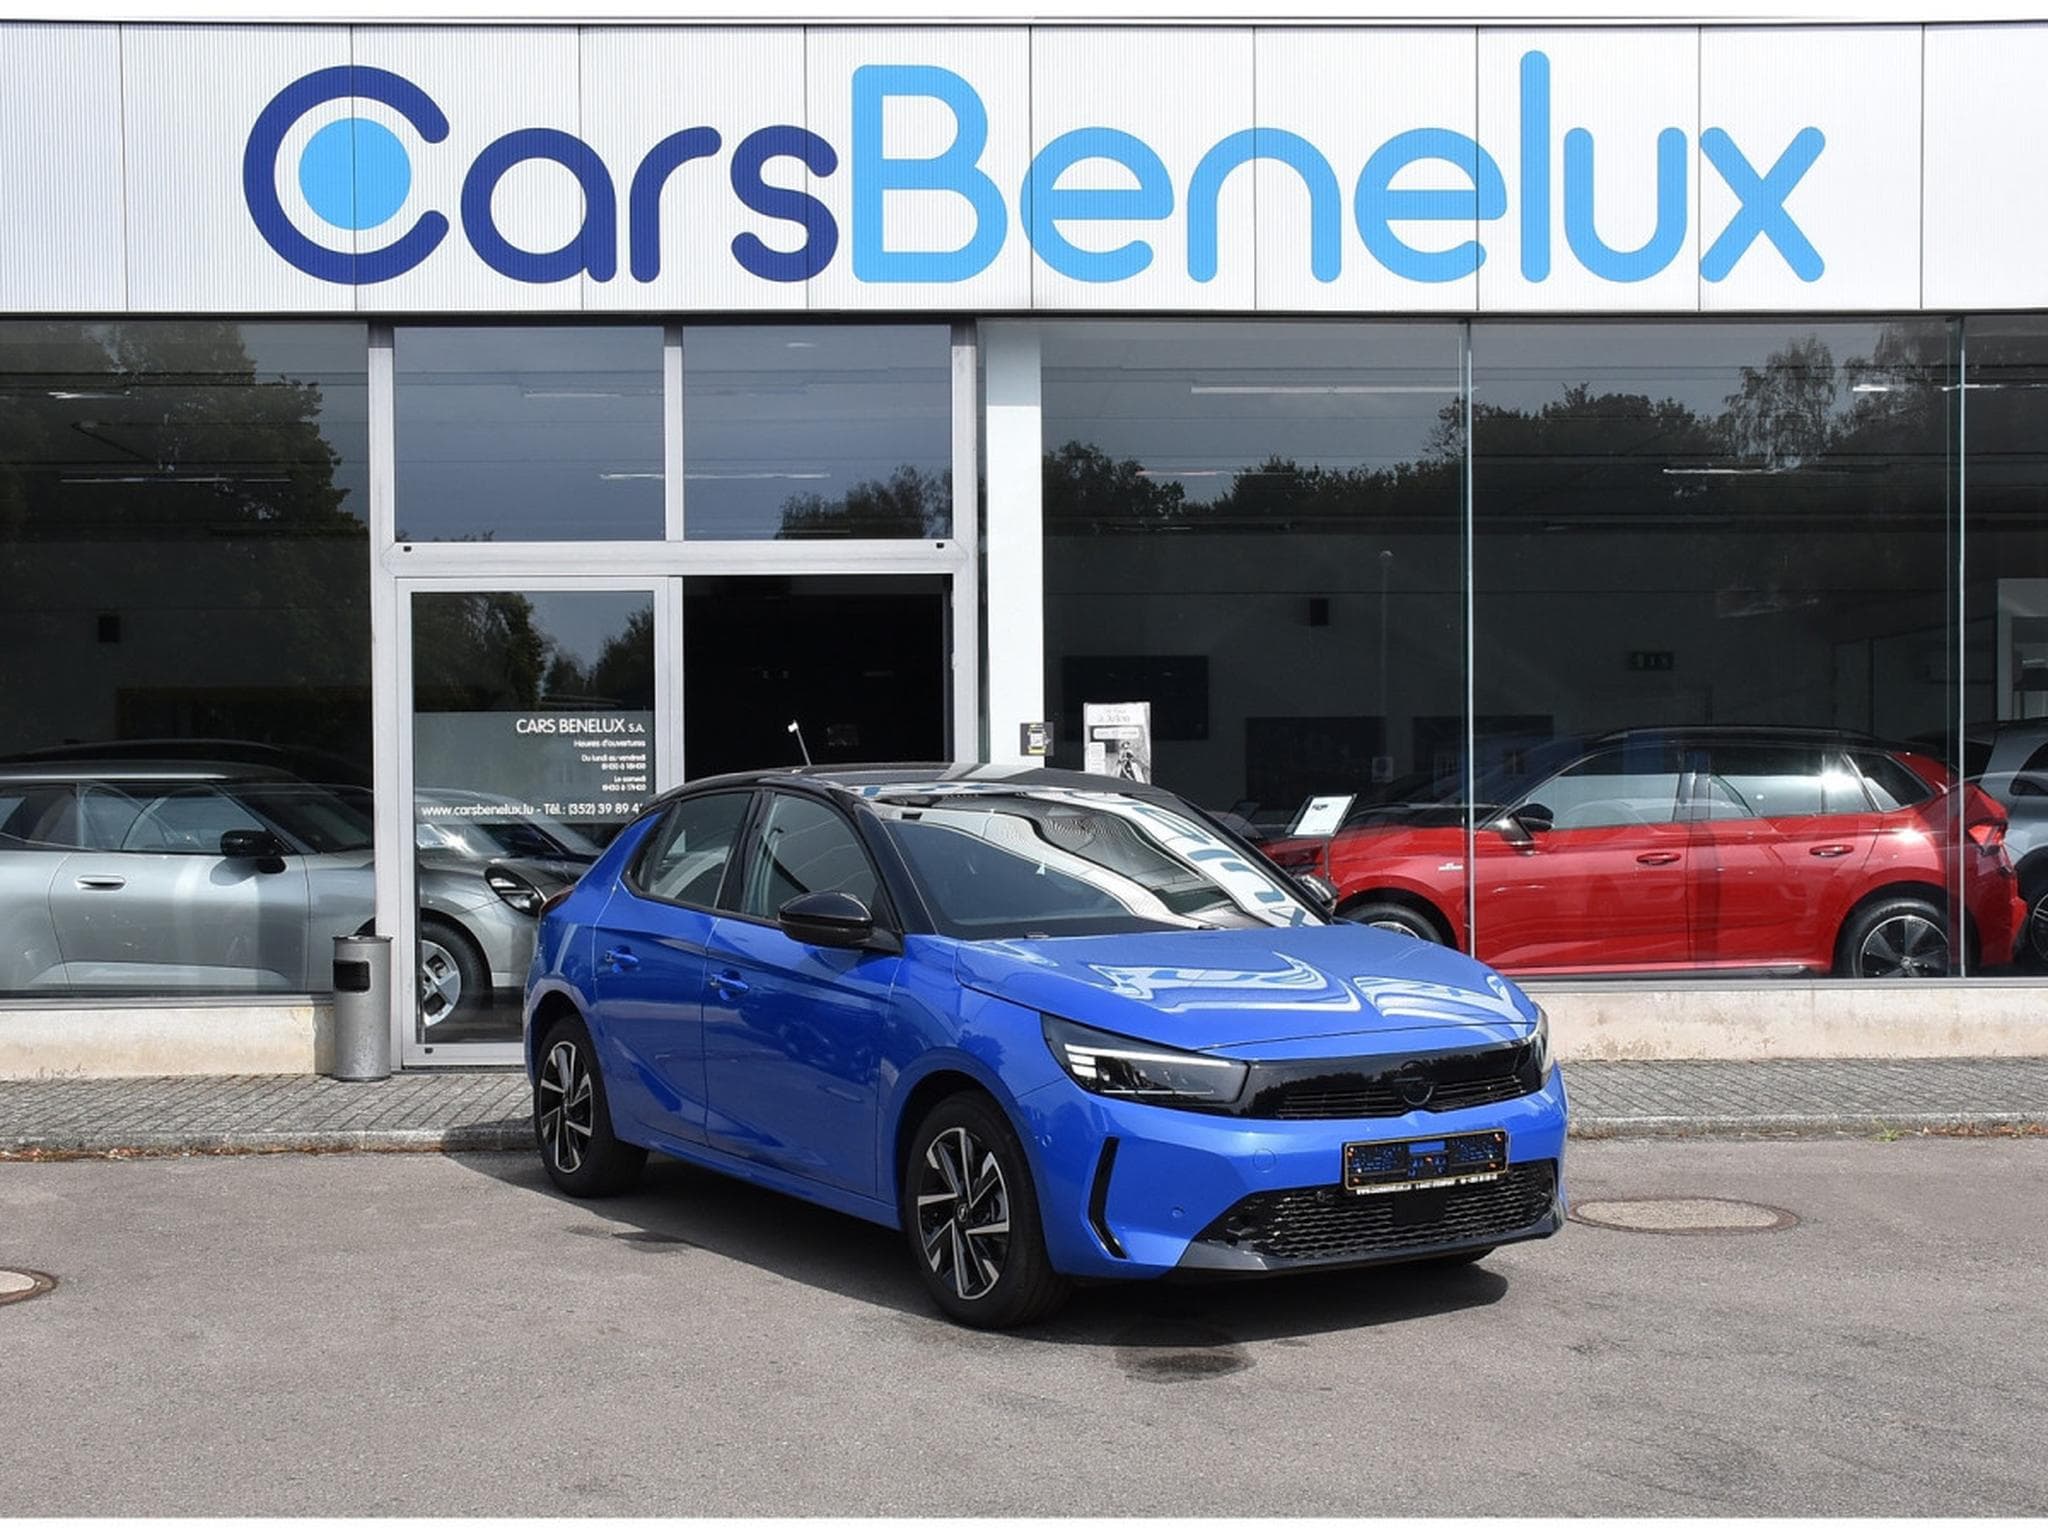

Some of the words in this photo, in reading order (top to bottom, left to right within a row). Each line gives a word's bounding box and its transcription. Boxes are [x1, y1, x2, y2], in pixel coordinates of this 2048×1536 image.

[516, 719, 556, 733] CARS
[559, 719, 626, 733] BENELUX
[573, 740, 600, 748] Heures
[421, 804, 534, 816] www.carsbenelux.lu
[568, 803, 596, 816] (352)
[598, 803, 612, 815] 39
[615, 803, 629, 815] 89
